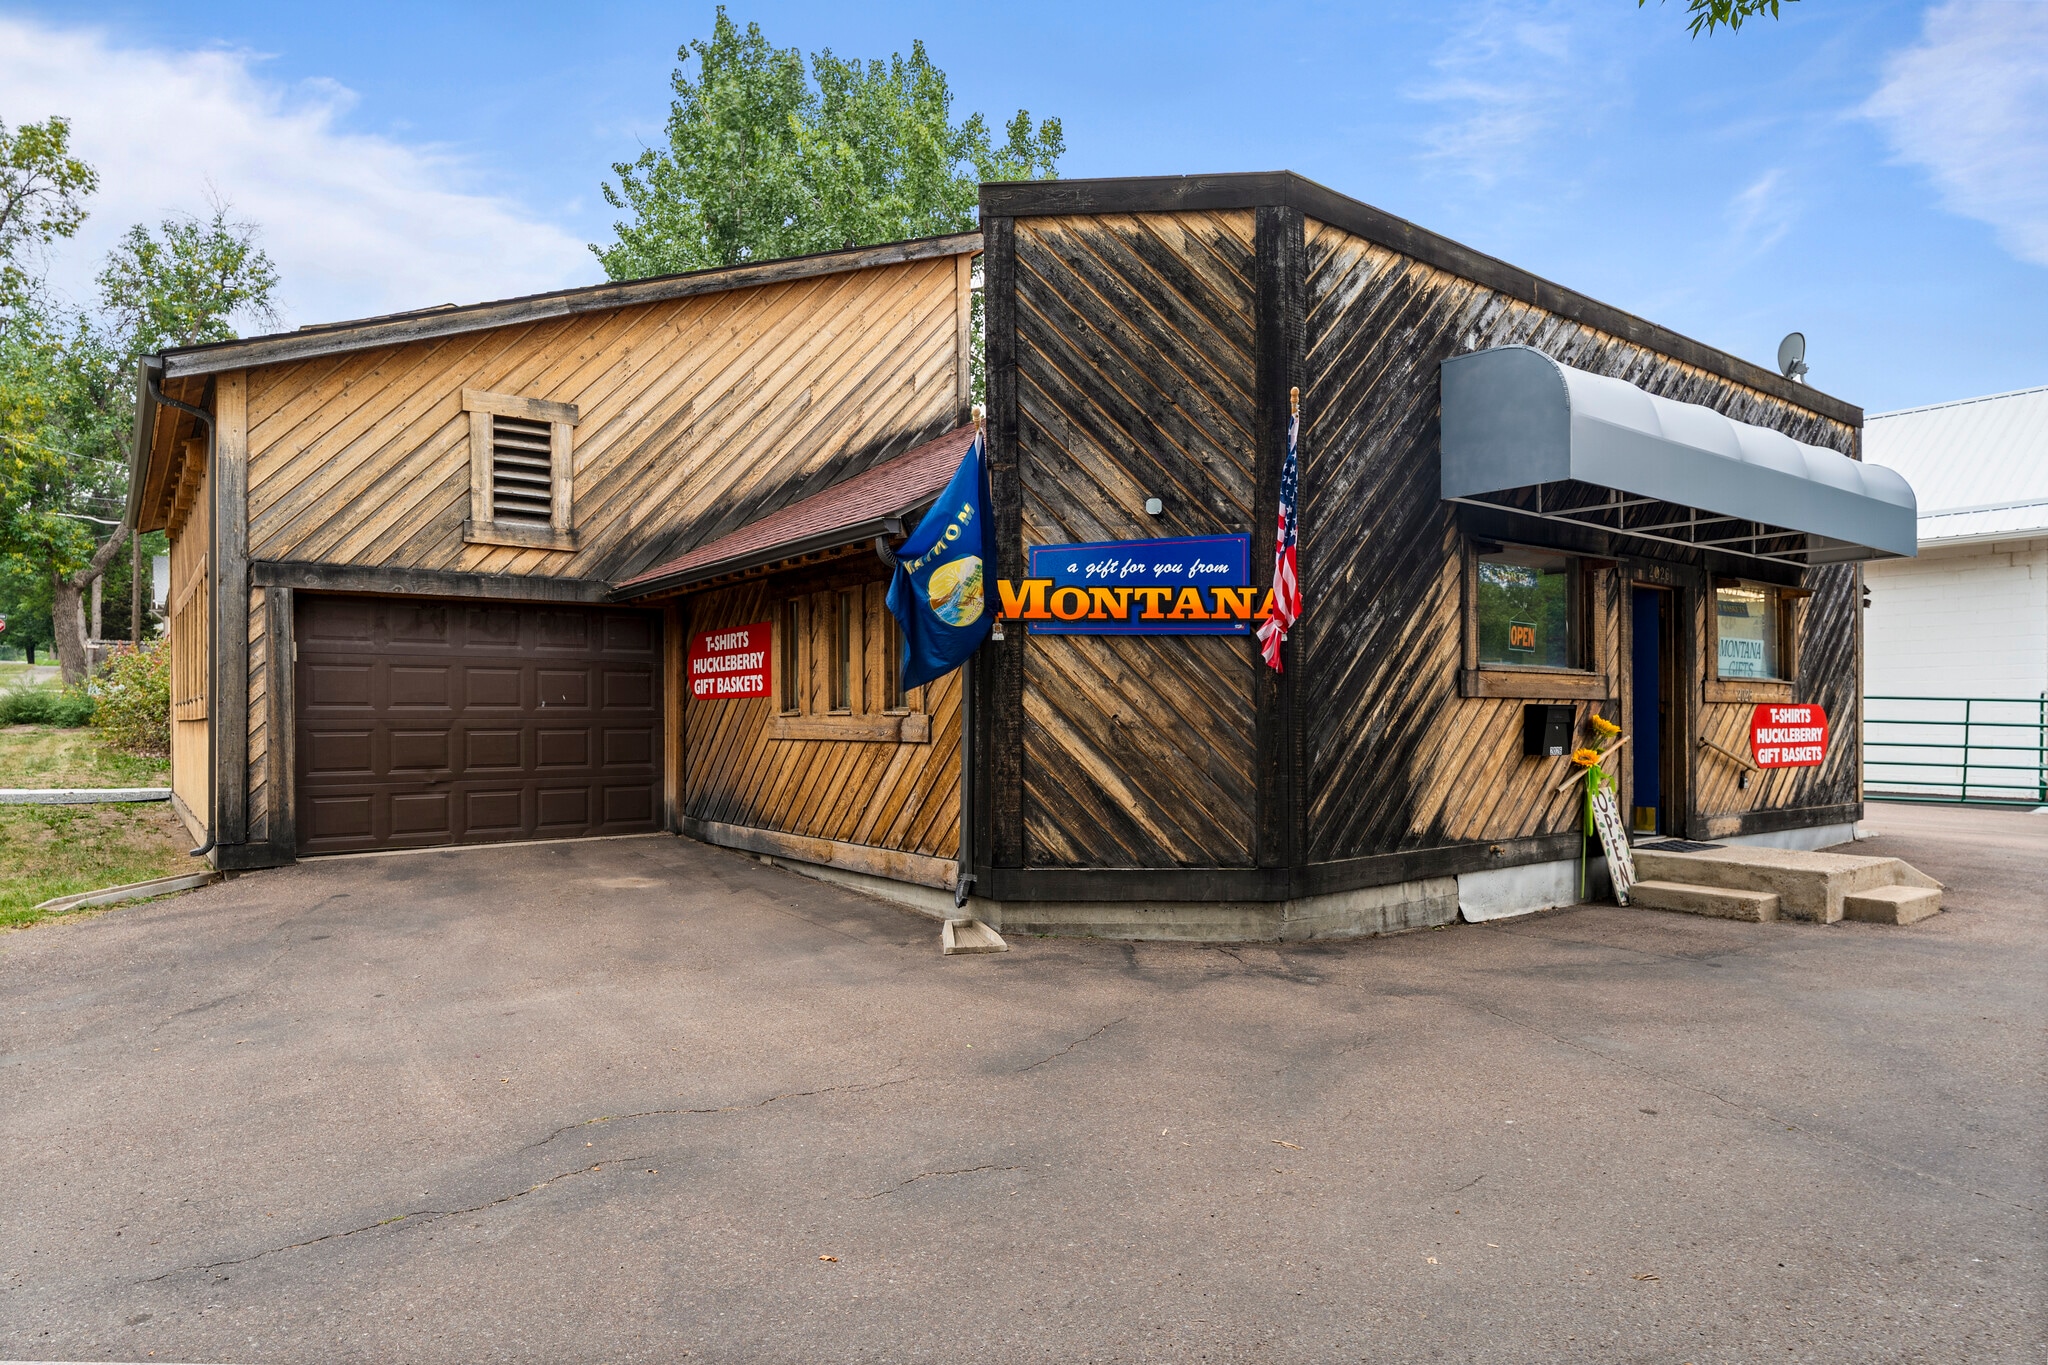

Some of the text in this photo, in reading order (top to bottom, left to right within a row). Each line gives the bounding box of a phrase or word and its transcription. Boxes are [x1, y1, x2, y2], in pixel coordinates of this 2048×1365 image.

[1066, 558, 1230, 579] a gift for you from
[706, 631, 749, 652] T-SHIRTS
[1511, 625, 1535, 648] OPEN
[1719, 639, 1761, 660] MONTANA
[693, 651, 765, 674] HUCKLEBERRY
[1728, 660, 1754, 677] GIFTS
[694, 674, 764, 695] GIFT BASKETS
[1770, 708, 1811, 723] T-SHIRTS
[1756, 727, 1823, 744] HUCKLEBERRY
[1758, 746, 1823, 764] GIFT BASKETS
[1596, 790, 1630, 888] OPEN
